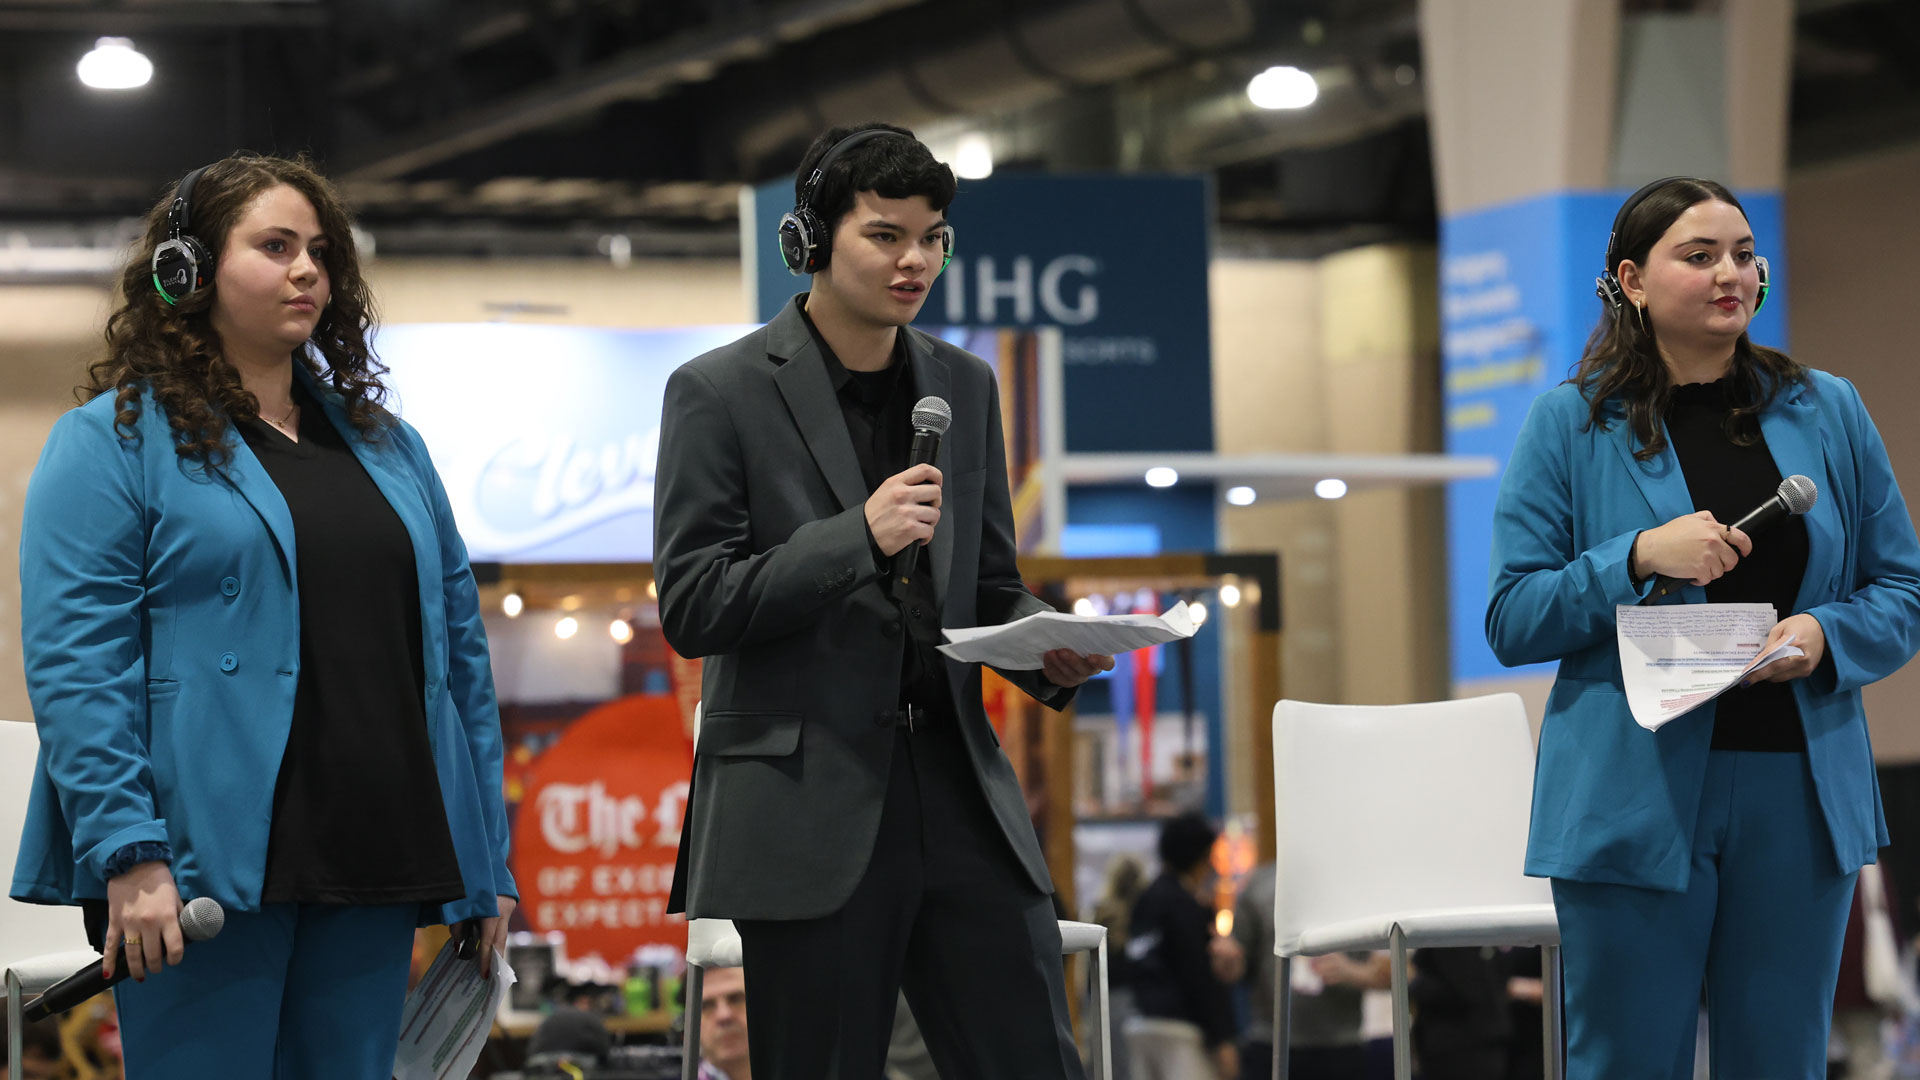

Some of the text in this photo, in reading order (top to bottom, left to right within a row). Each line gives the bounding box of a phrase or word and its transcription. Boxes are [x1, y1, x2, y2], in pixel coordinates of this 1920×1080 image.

[945, 254, 1100, 325] IHG
[536, 781, 645, 858] The
[537, 898, 687, 928] EXPECT
